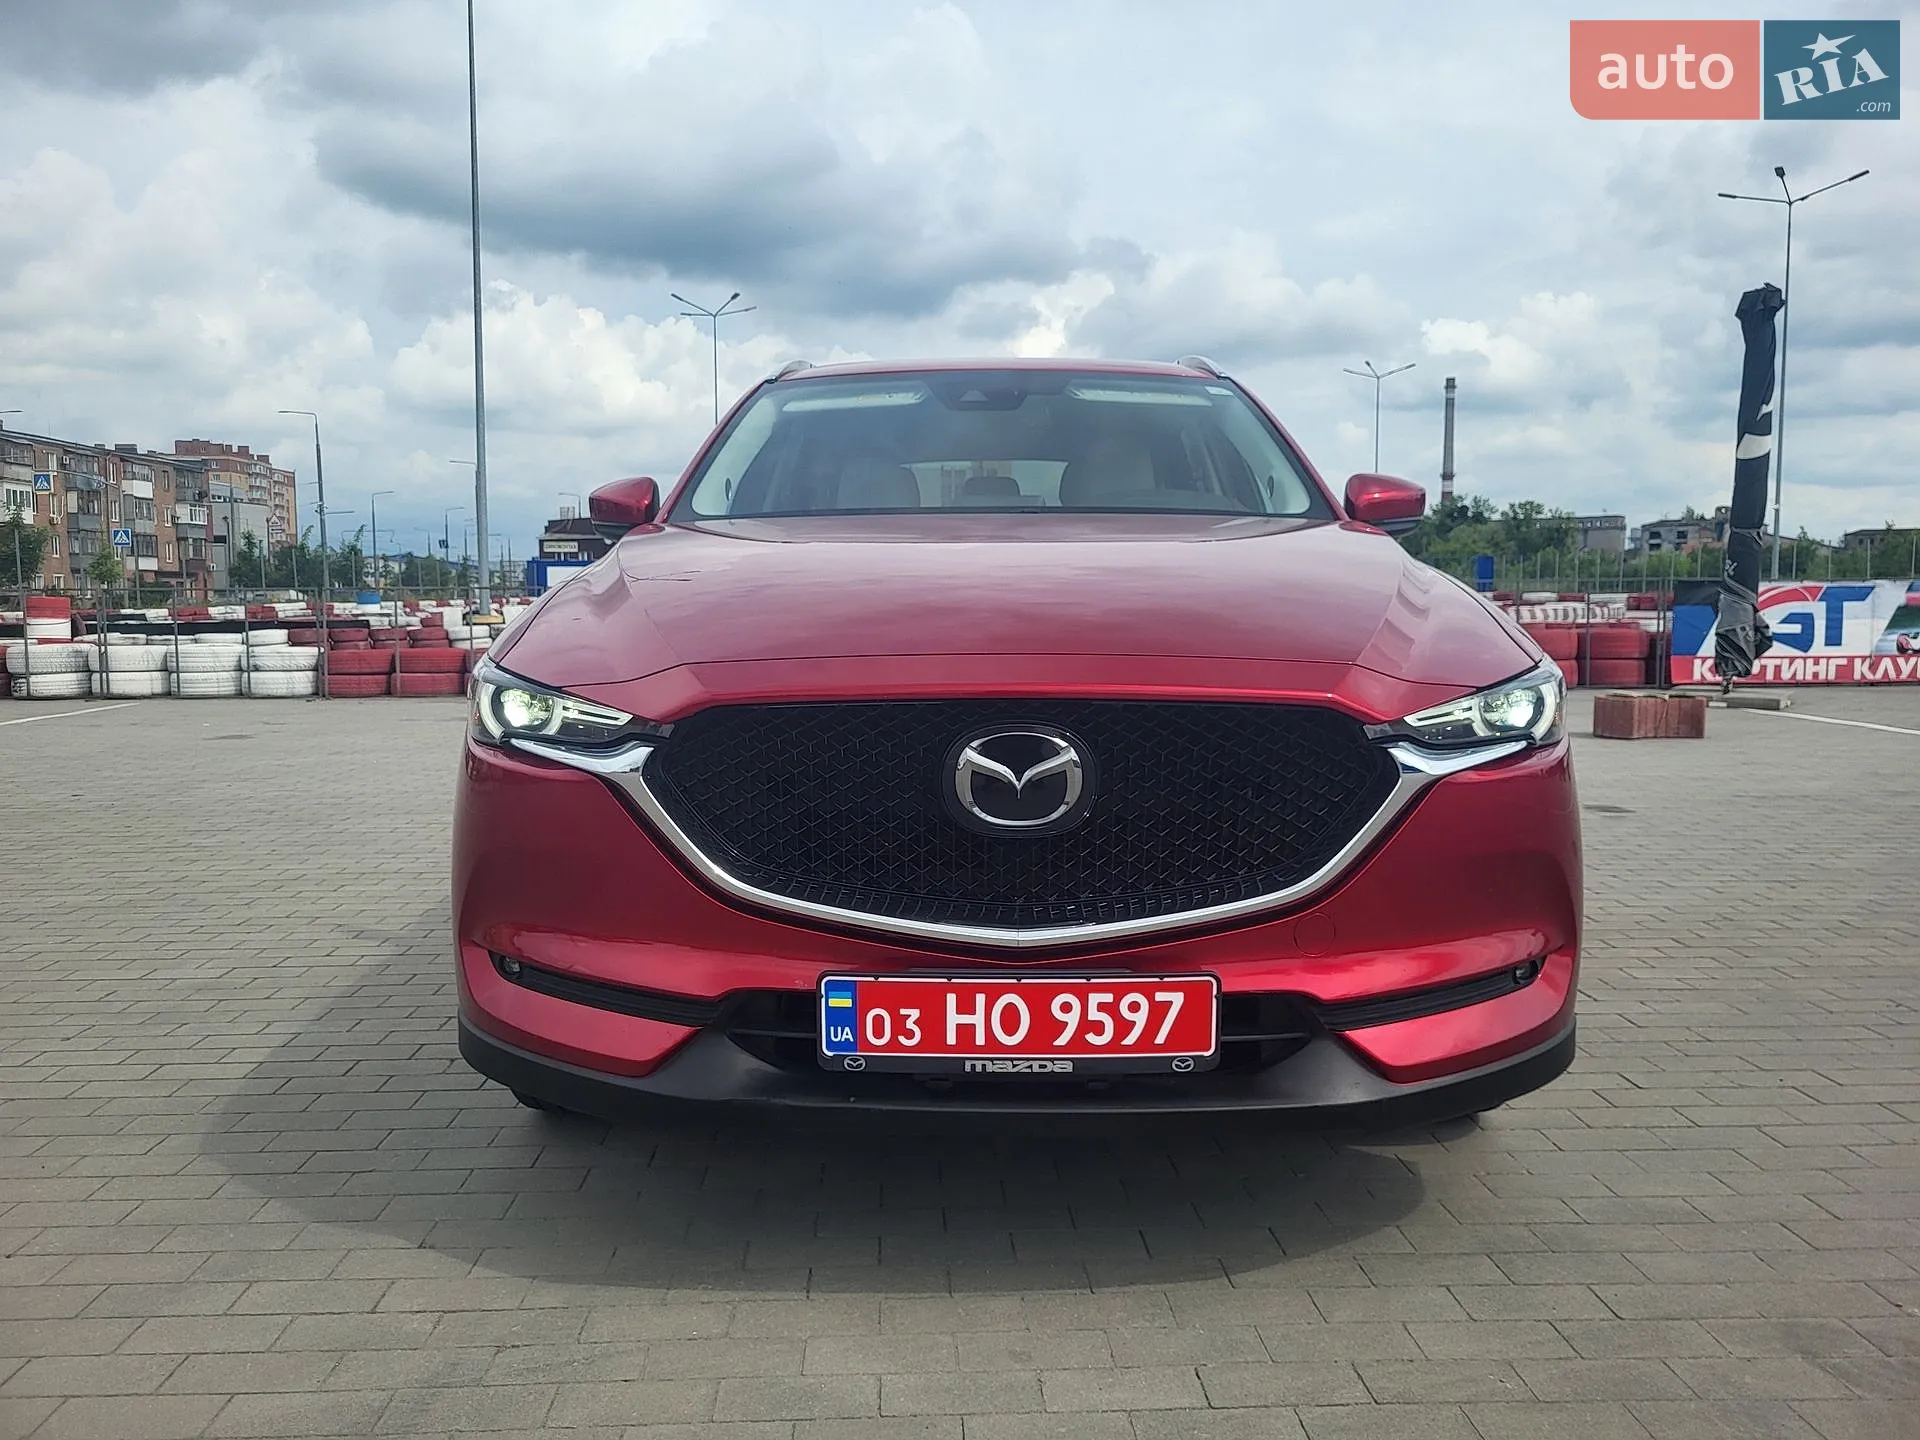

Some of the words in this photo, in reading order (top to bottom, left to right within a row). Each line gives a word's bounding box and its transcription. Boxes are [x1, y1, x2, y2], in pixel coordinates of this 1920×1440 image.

[1693, 656, 1847, 681] КТИНГ
[1853, 656, 1920, 681] КЛУ
[865, 1007, 922, 1047] 03
[946, 993, 1031, 1046] HO
[1050, 992, 1185, 1046] 9597
[829, 1026, 854, 1042] UA
[964, 1059, 1073, 1073] mazda
